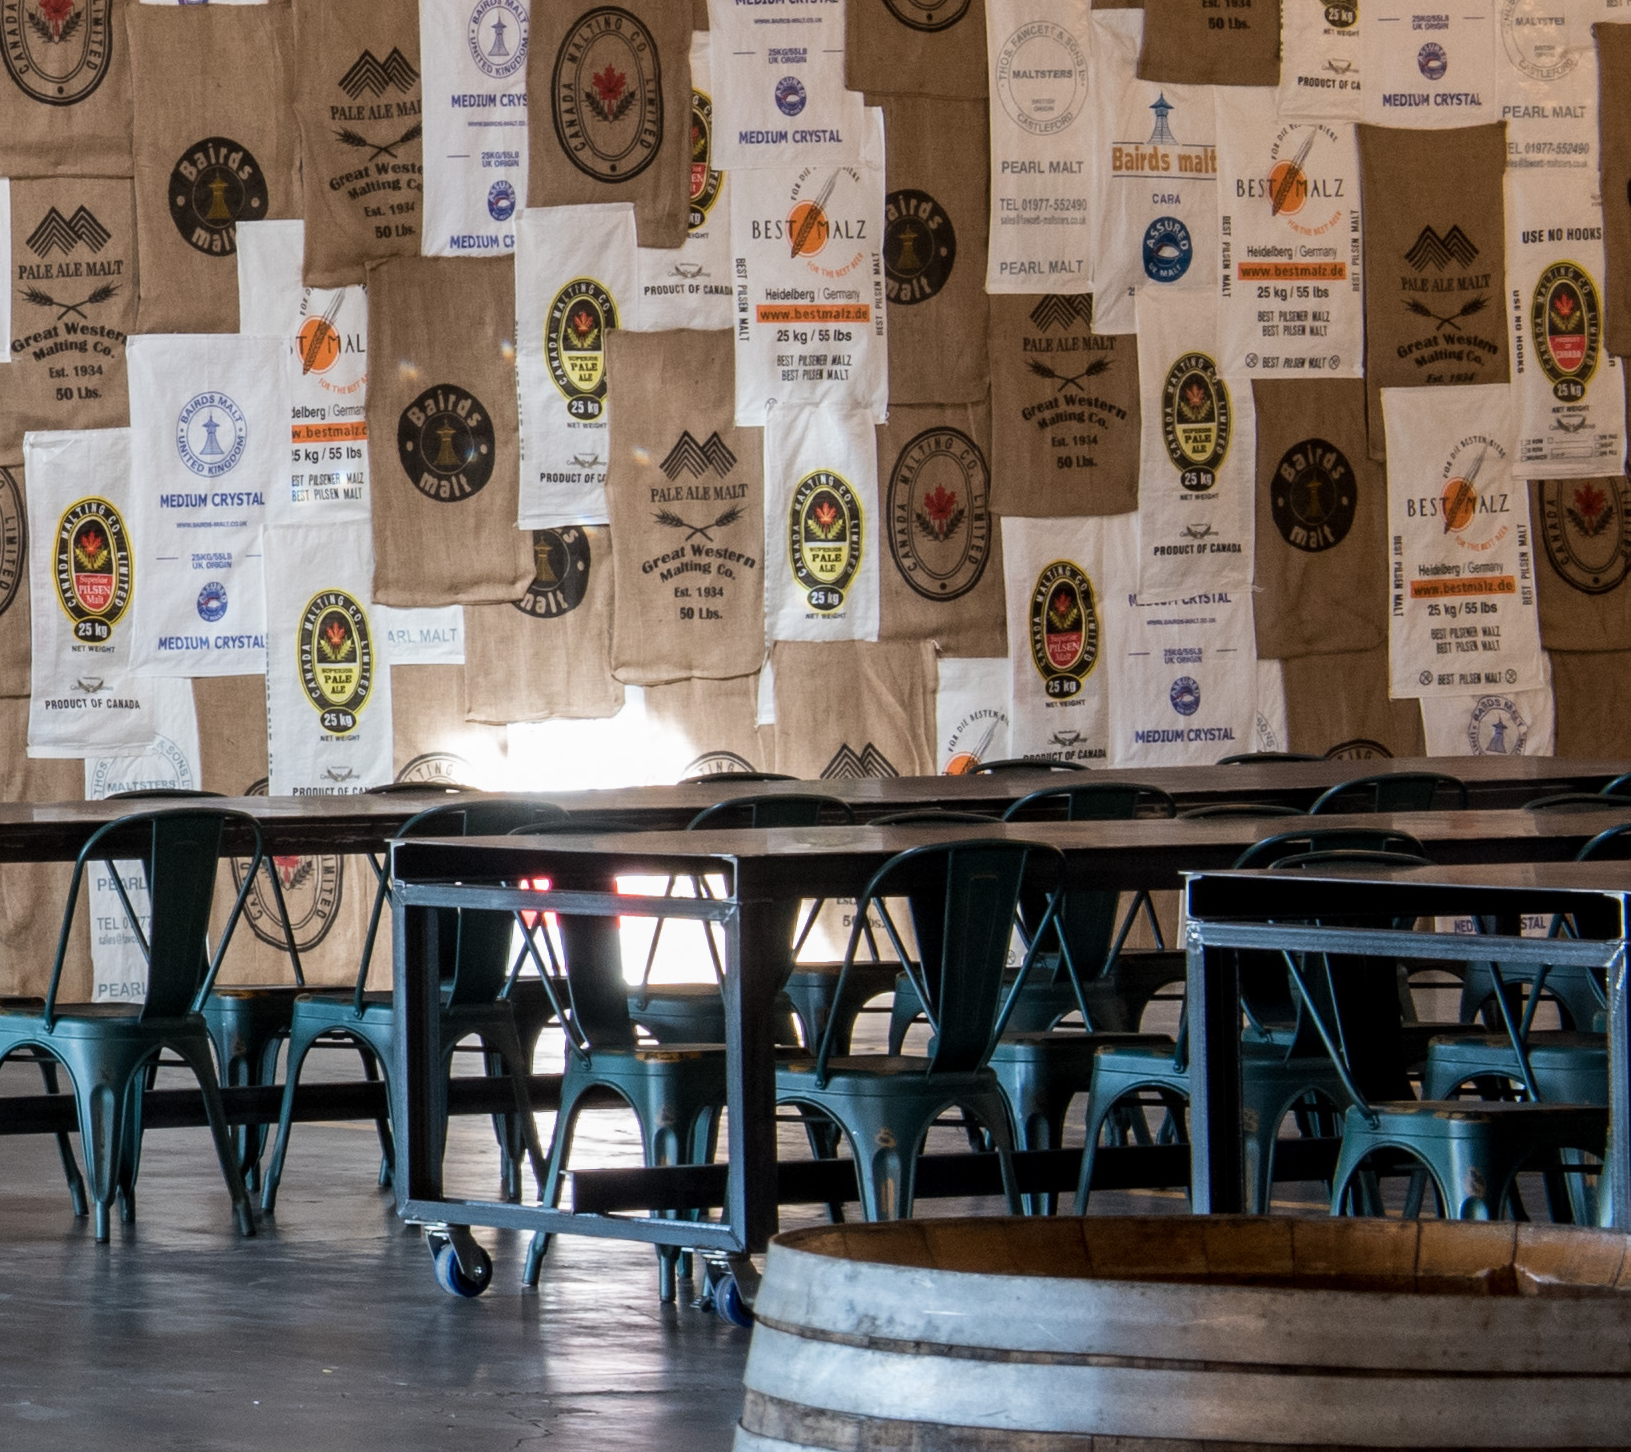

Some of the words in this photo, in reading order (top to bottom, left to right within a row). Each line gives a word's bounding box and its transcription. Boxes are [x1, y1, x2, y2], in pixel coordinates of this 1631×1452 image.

[1012, 69, 1073, 80] MALTSTERS
[1001, 161, 1045, 174] PEARL
[1048, 160, 1084, 174] MALT
[1112, 147, 1173, 172] Bairds
[1178, 148, 1217, 174] malt
[1000, 198, 1019, 212] TEL
[1021, 198, 1087, 212] 01977-552490
[1152, 193, 1181, 205] CARA
[751, 219, 795, 240] BEST
[817, 219, 866, 240] MALZ
[1522, 230, 1543, 244] USE
[1547, 229, 1563, 243] NO
[1566, 227, 1602, 242] HOOKS
[1241, 265, 1345, 278] www.bestmalz.de
[765, 287, 815, 302] Heidelberg
[823, 288, 860, 303] Germany
[759, 306, 869, 322] www.bestmalz.de
[777, 330, 789, 342] 25
[791, 329, 809, 344] kg
[818, 329, 830, 342] 55
[833, 330, 852, 342] lbs
[408, 392, 483, 427] Bairds
[418, 471, 472, 498] malt
[160, 493, 210, 508] MEDIUM
[212, 492, 265, 507] CRYSTAL
[650, 487, 684, 502] PALE
[686, 486, 710, 502] ALE
[713, 484, 749, 500] MALT
